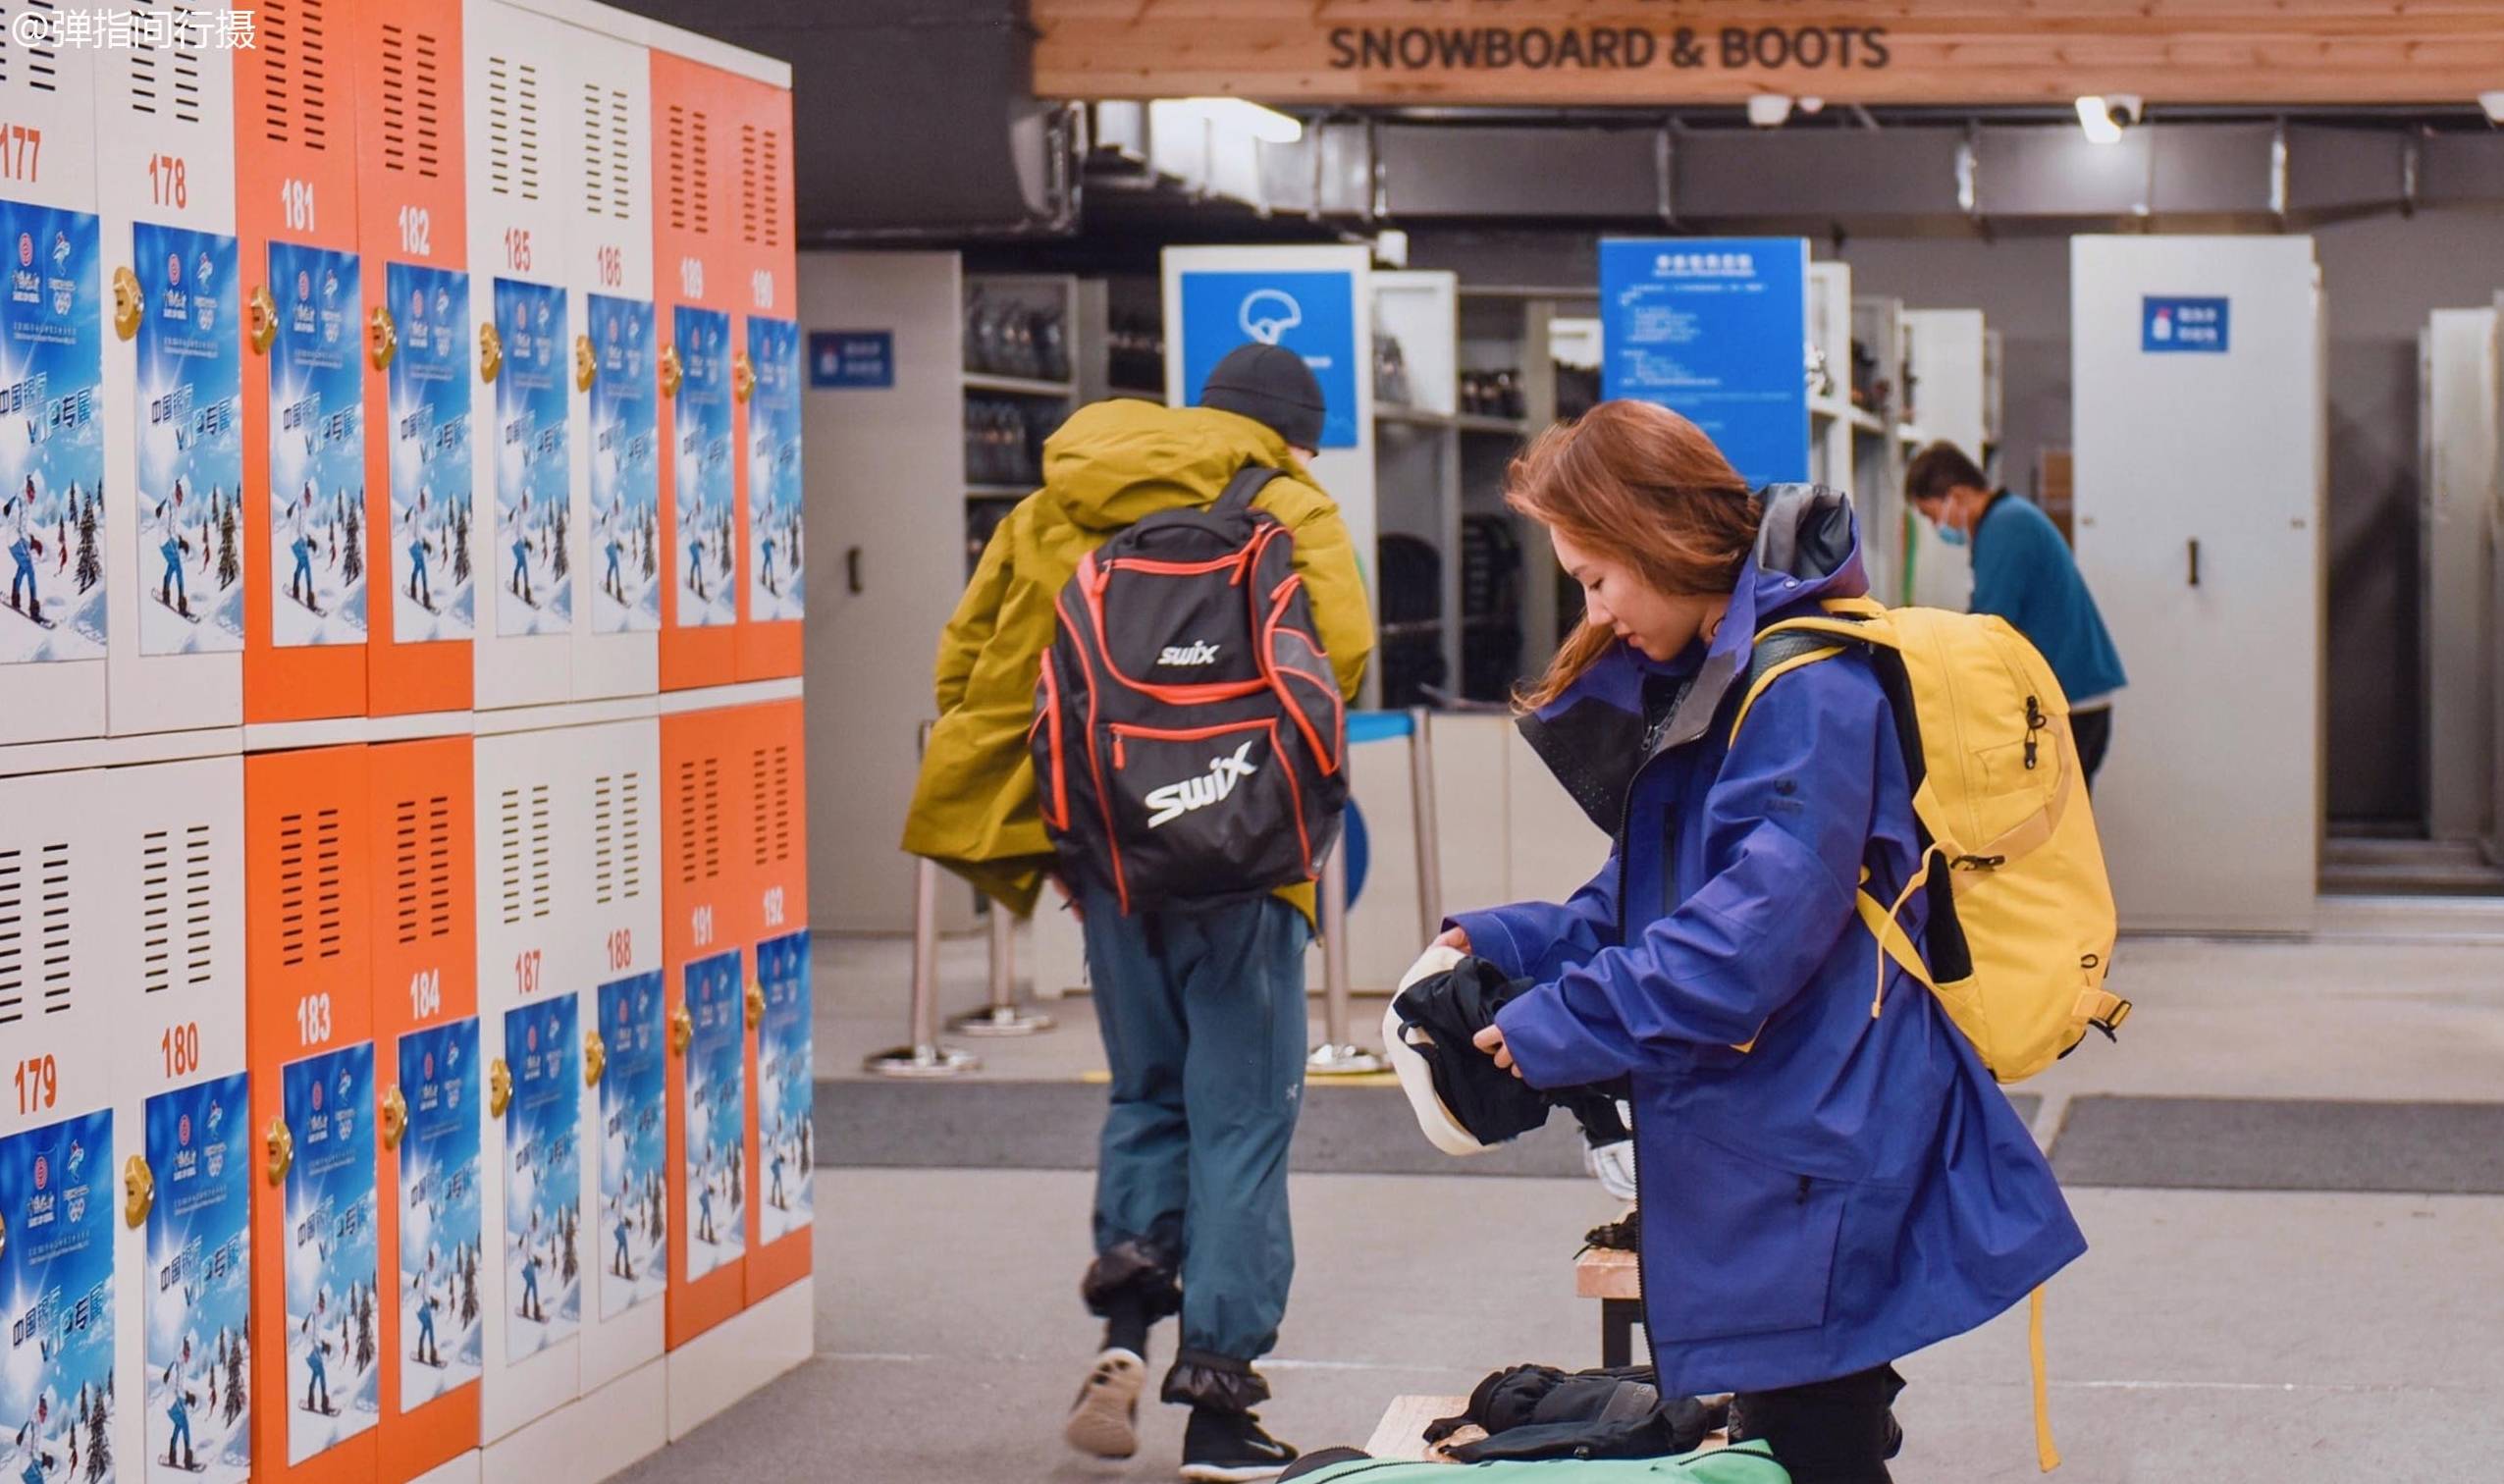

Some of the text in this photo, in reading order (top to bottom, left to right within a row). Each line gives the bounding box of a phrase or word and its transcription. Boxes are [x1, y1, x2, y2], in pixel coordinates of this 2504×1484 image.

[1329, 26, 1891, 70] SNOWBOARD & BOOTS
[0, 123, 41, 183] 177
[149, 153, 186, 209] 178
[281, 178, 315, 233] 181
[399, 205, 431, 255] 182
[506, 227, 531, 273] 185
[598, 245, 621, 288] 186
[515, 949, 541, 995] 187
[608, 928, 631, 972] 188
[297, 992, 331, 1046] 183
[410, 968, 440, 1020] 184
[162, 1022, 198, 1079] 180
[15, 1053, 57, 1115] 179
[13, 1285, 61, 1348] 中国银行
